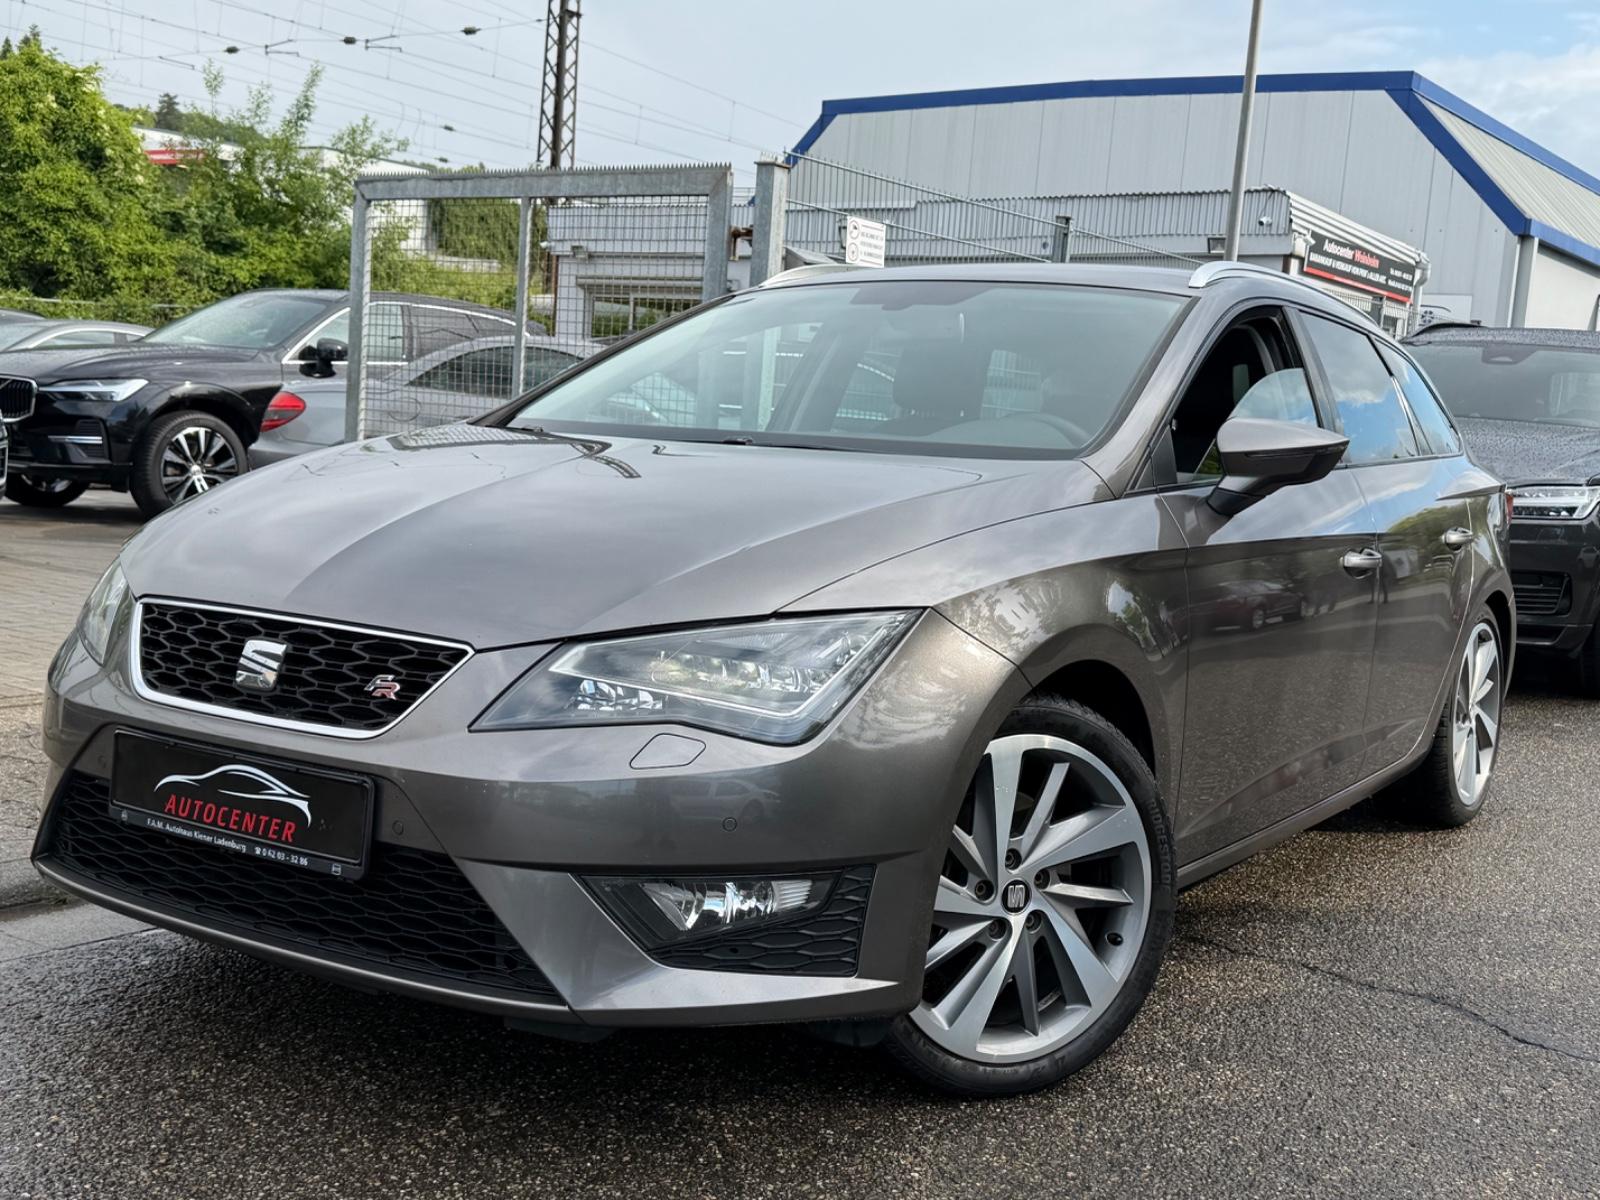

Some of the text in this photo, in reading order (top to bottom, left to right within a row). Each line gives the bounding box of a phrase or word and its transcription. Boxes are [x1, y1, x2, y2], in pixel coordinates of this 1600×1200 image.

[1323, 239, 1355, 260] Autocenter
[364, 674, 400, 700] FR
[165, 794, 296, 842] AUTOCENTER
[165, 823, 193, 837] Autohaus
[193, 830, 213, 842] Kiener
[213, 836, 246, 853] Ladenburg
[1146, 794, 1172, 894] RIDGESTONE
